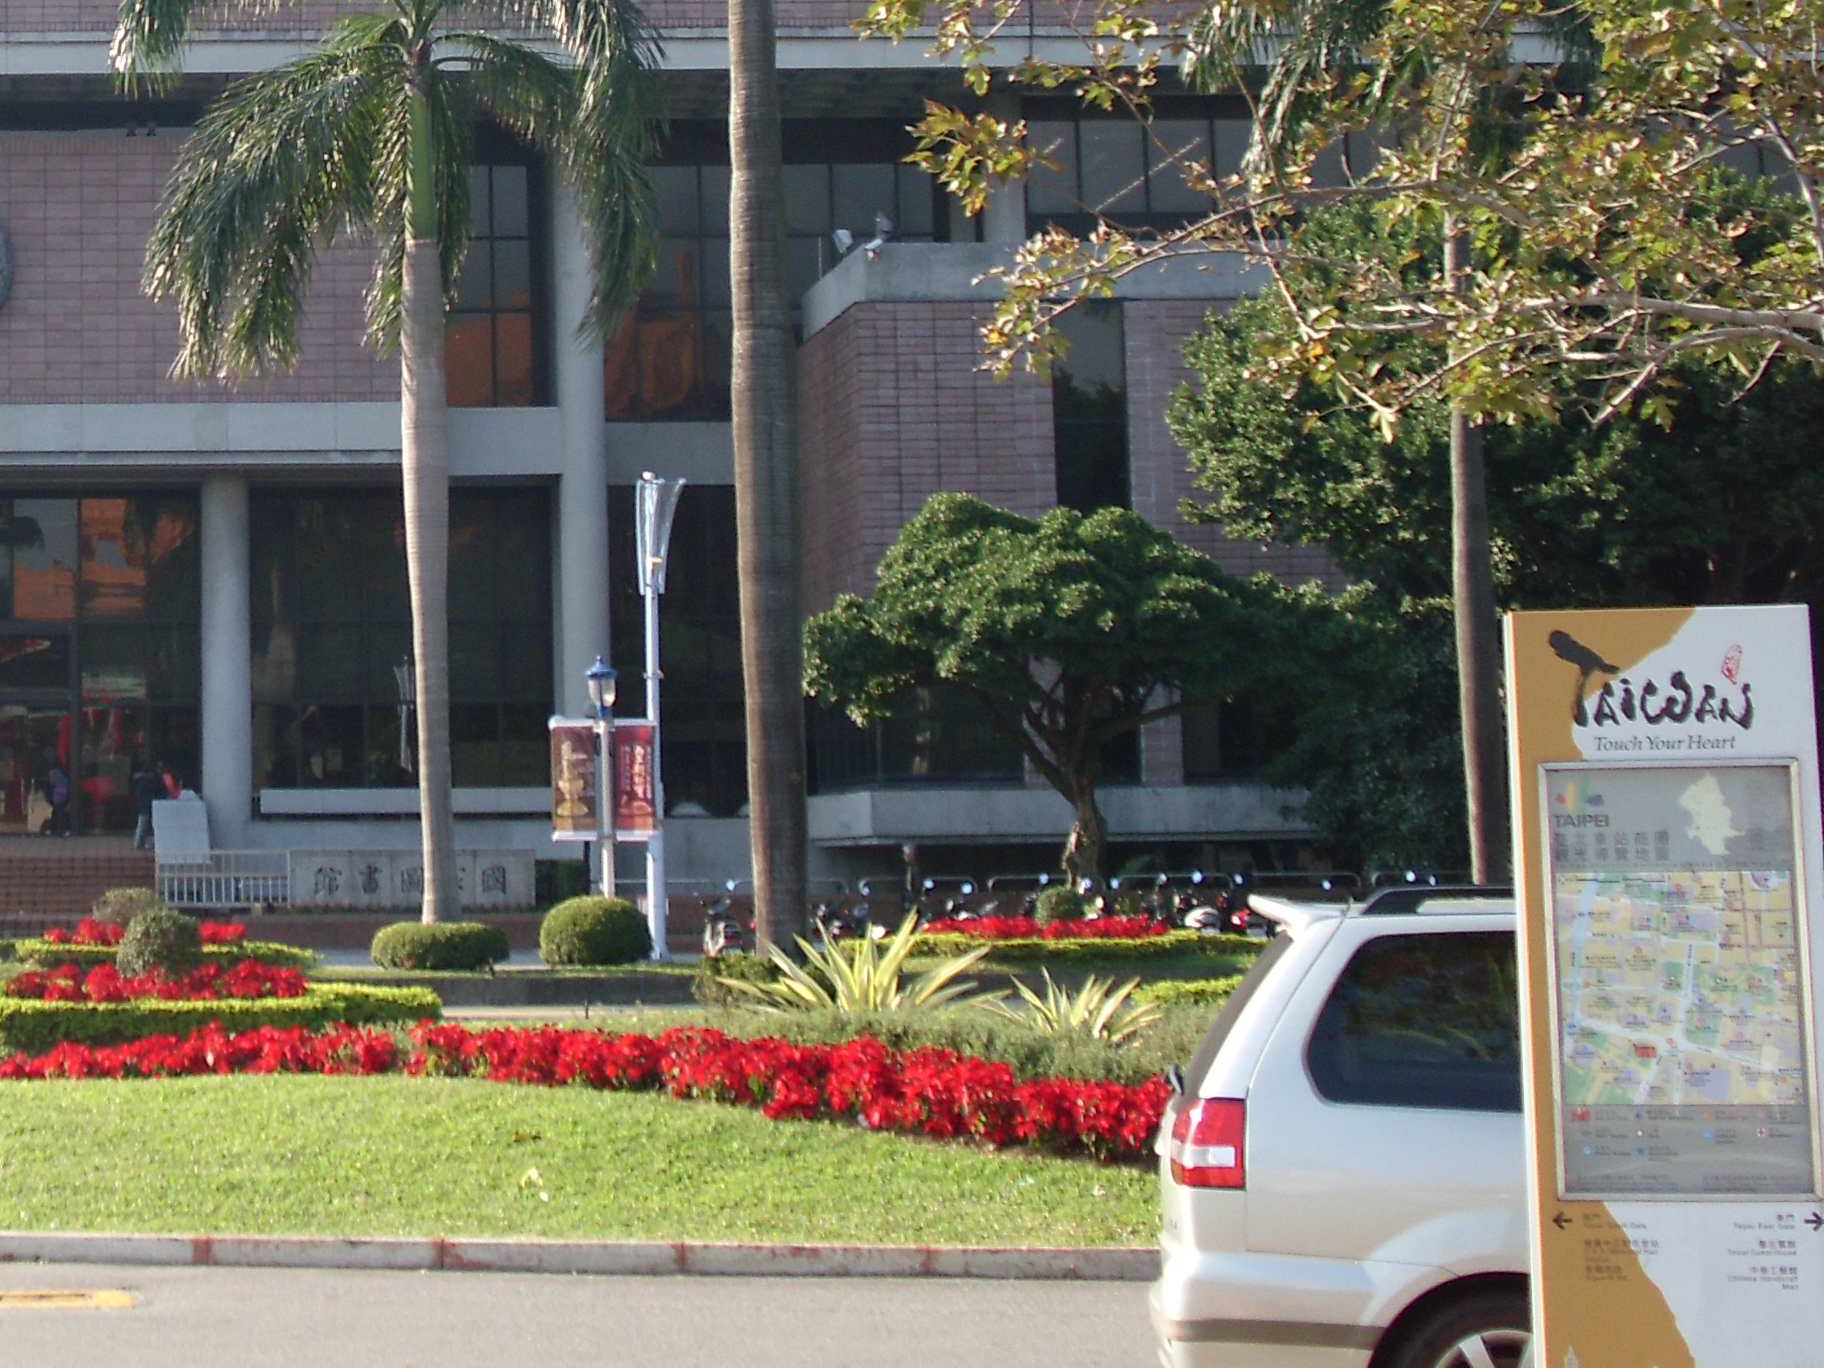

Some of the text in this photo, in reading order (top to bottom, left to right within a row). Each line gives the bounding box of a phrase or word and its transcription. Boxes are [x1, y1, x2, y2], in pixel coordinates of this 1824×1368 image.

[1594, 735, 1737, 751] Touch Your Heart
[1554, 813, 1609, 829] TAIPEI
